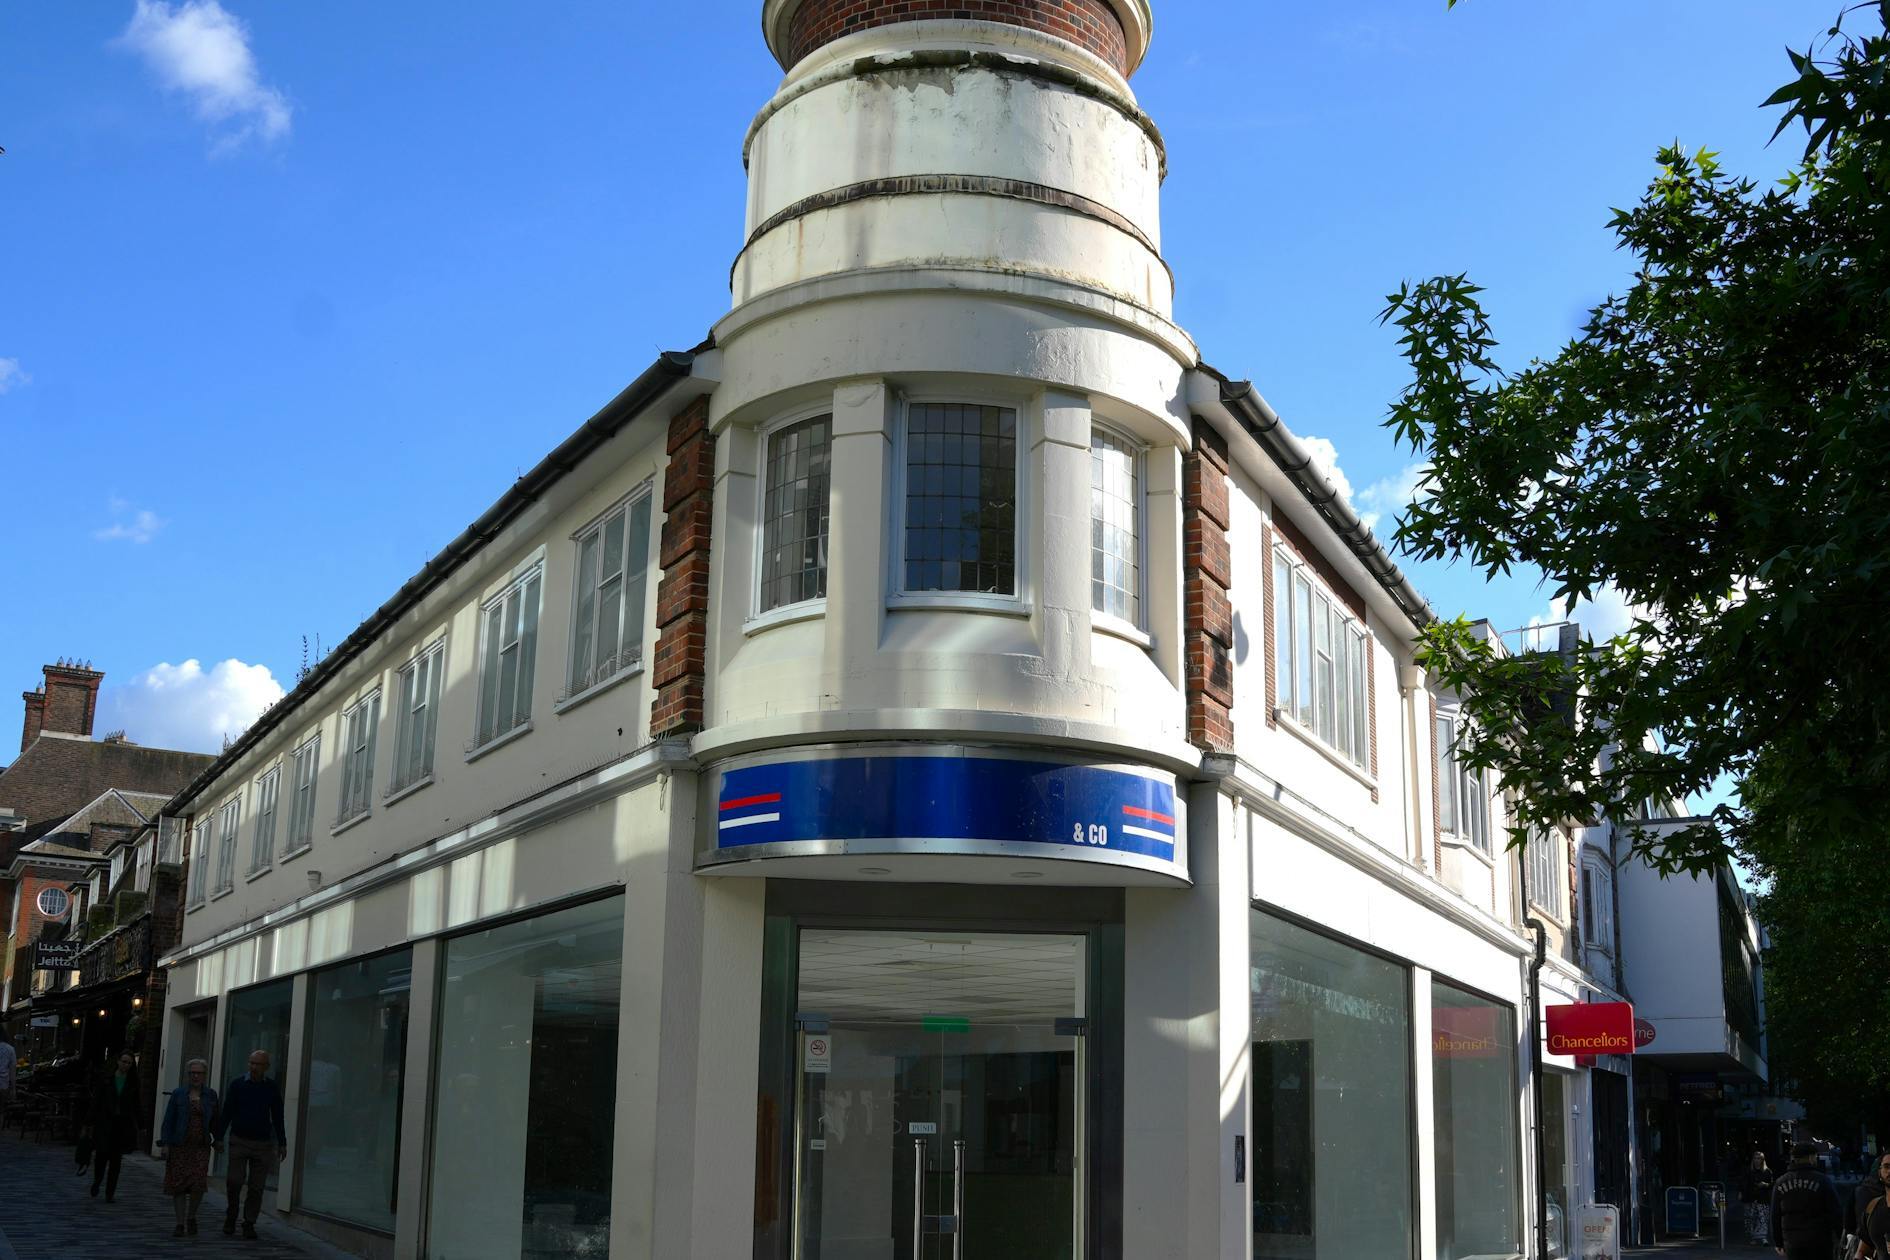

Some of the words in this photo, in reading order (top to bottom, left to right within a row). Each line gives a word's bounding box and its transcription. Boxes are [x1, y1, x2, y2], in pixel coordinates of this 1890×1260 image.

[1073, 822, 1085, 843] &
[1088, 823, 1108, 845] CO
[1551, 1032, 1628, 1048] Chancellors
